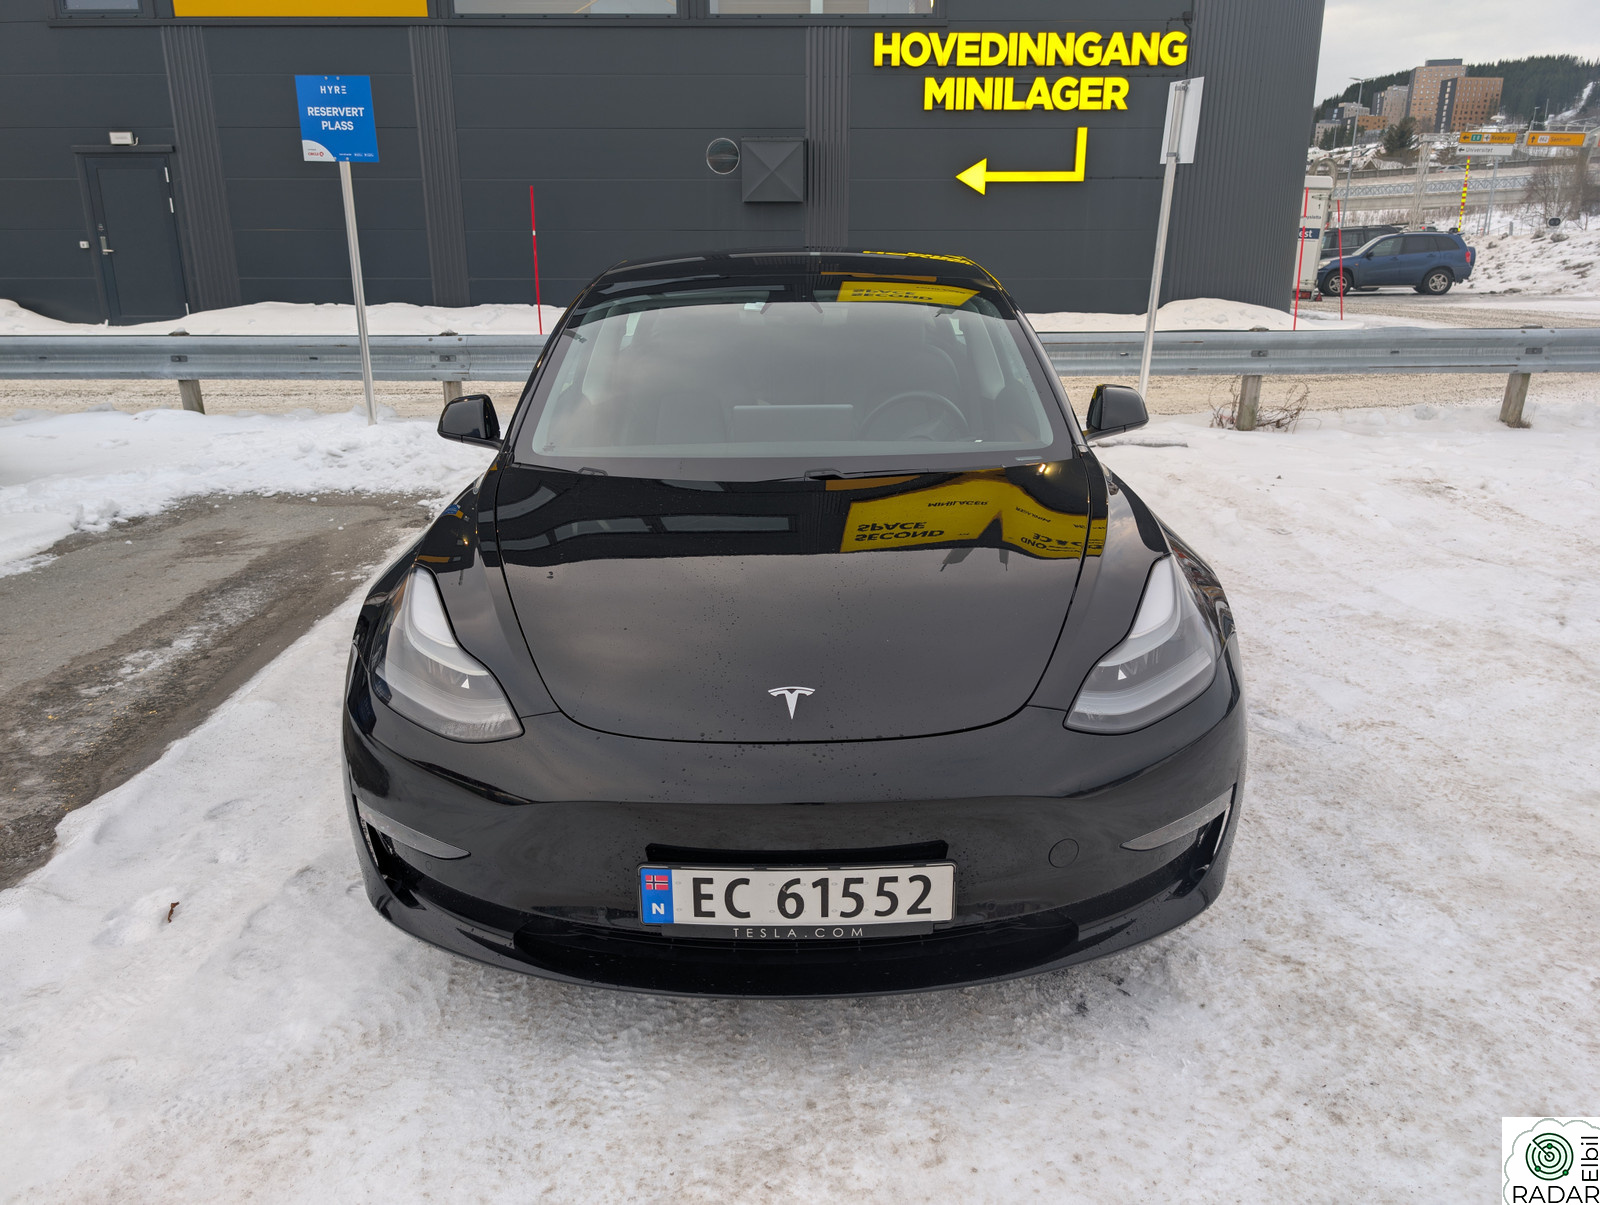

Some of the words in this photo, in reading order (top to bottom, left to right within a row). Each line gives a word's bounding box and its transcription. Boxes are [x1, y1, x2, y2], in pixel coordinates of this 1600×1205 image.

[873, 31, 1188, 67] HOVEDINNGANG
[320, 85, 347, 94] HYRE
[923, 76, 1130, 111] MINILAGER
[307, 106, 365, 117] RESERVERT
[321, 120, 354, 131] PLASS
[692, 876, 751, 918] EC
[777, 874, 932, 919] 61552
[651, 902, 665, 915] N
[732, 927, 864, 938] TESLA.COM
